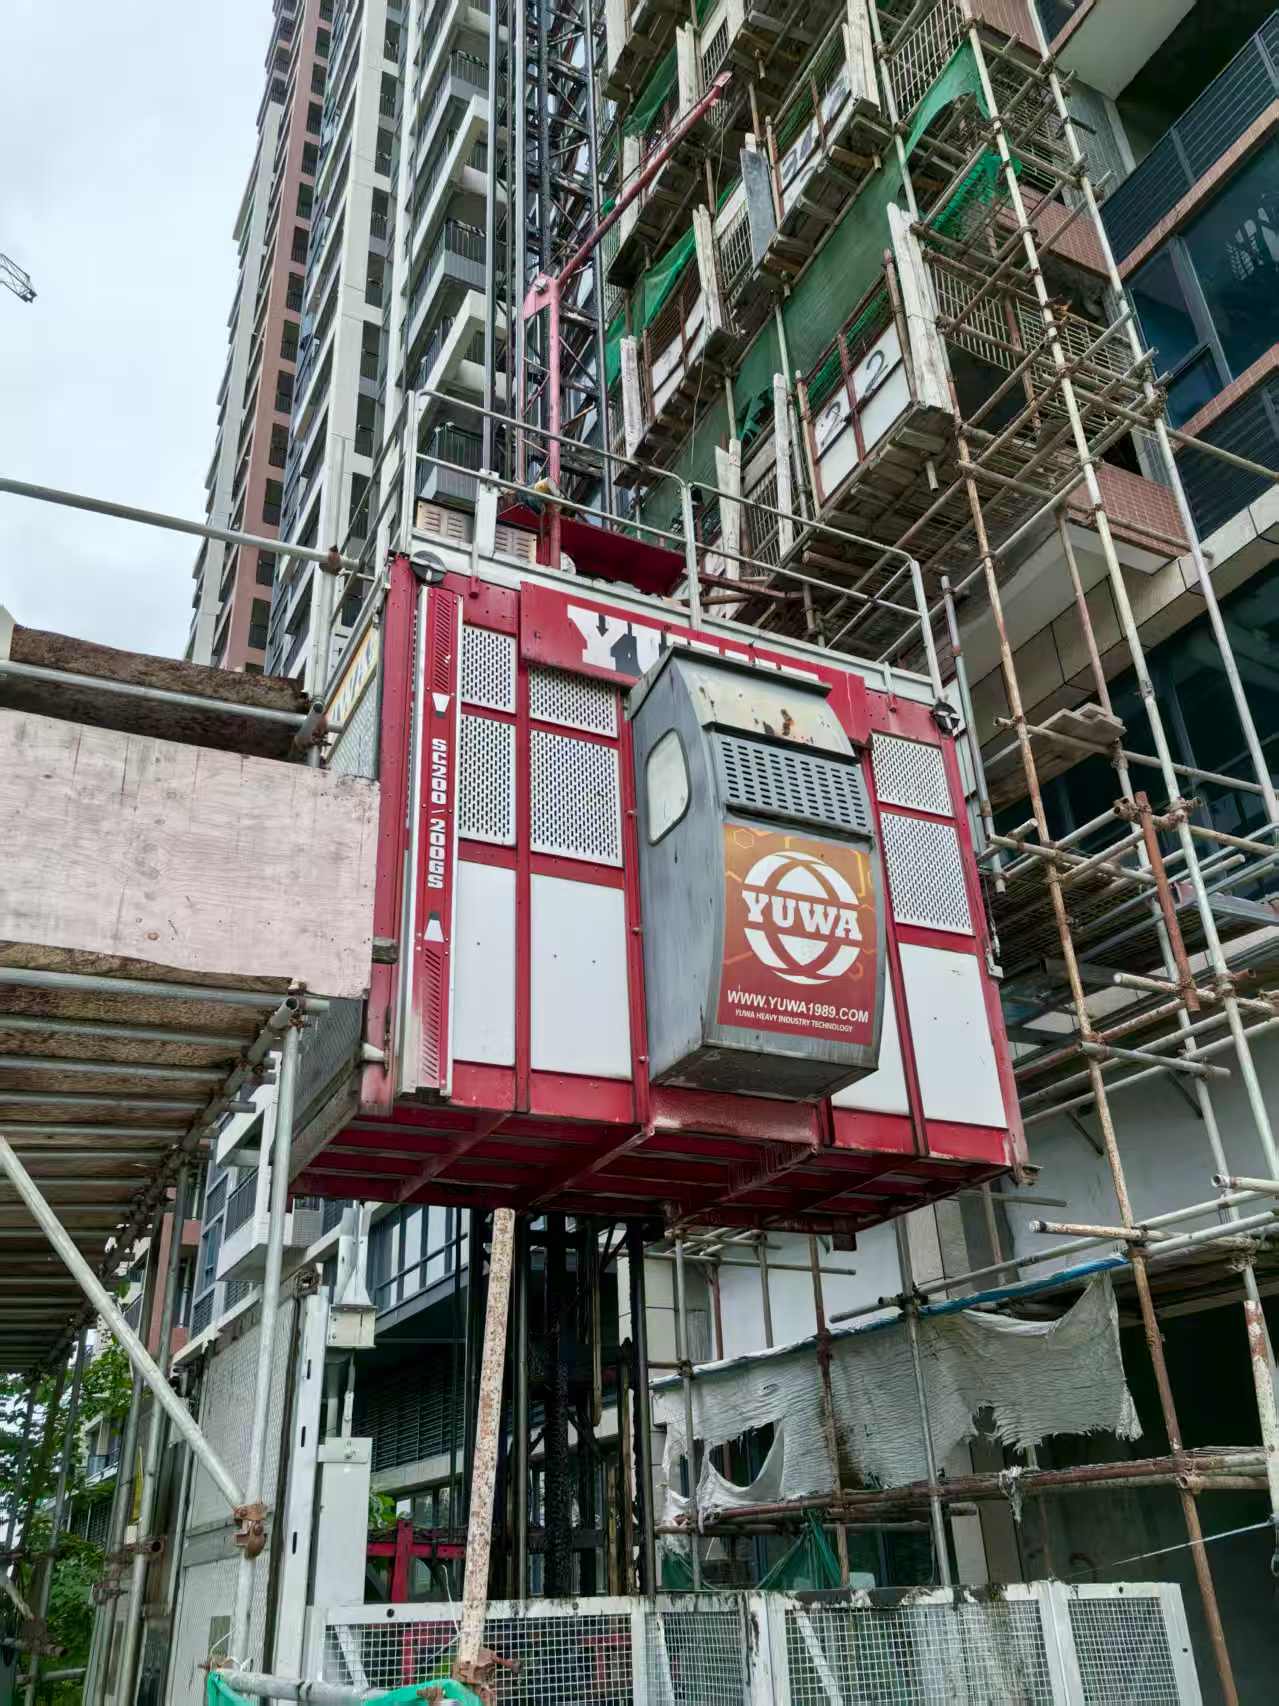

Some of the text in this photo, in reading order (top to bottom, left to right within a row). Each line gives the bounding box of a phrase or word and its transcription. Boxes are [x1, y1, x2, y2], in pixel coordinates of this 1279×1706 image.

[741, 889, 863, 941] YUWA
[728, 990, 869, 1023] WWW.YUWA1989.COM
[735, 1009, 853, 1033] YUWA HEAVY INDUSTRY TECHNOLOGY
